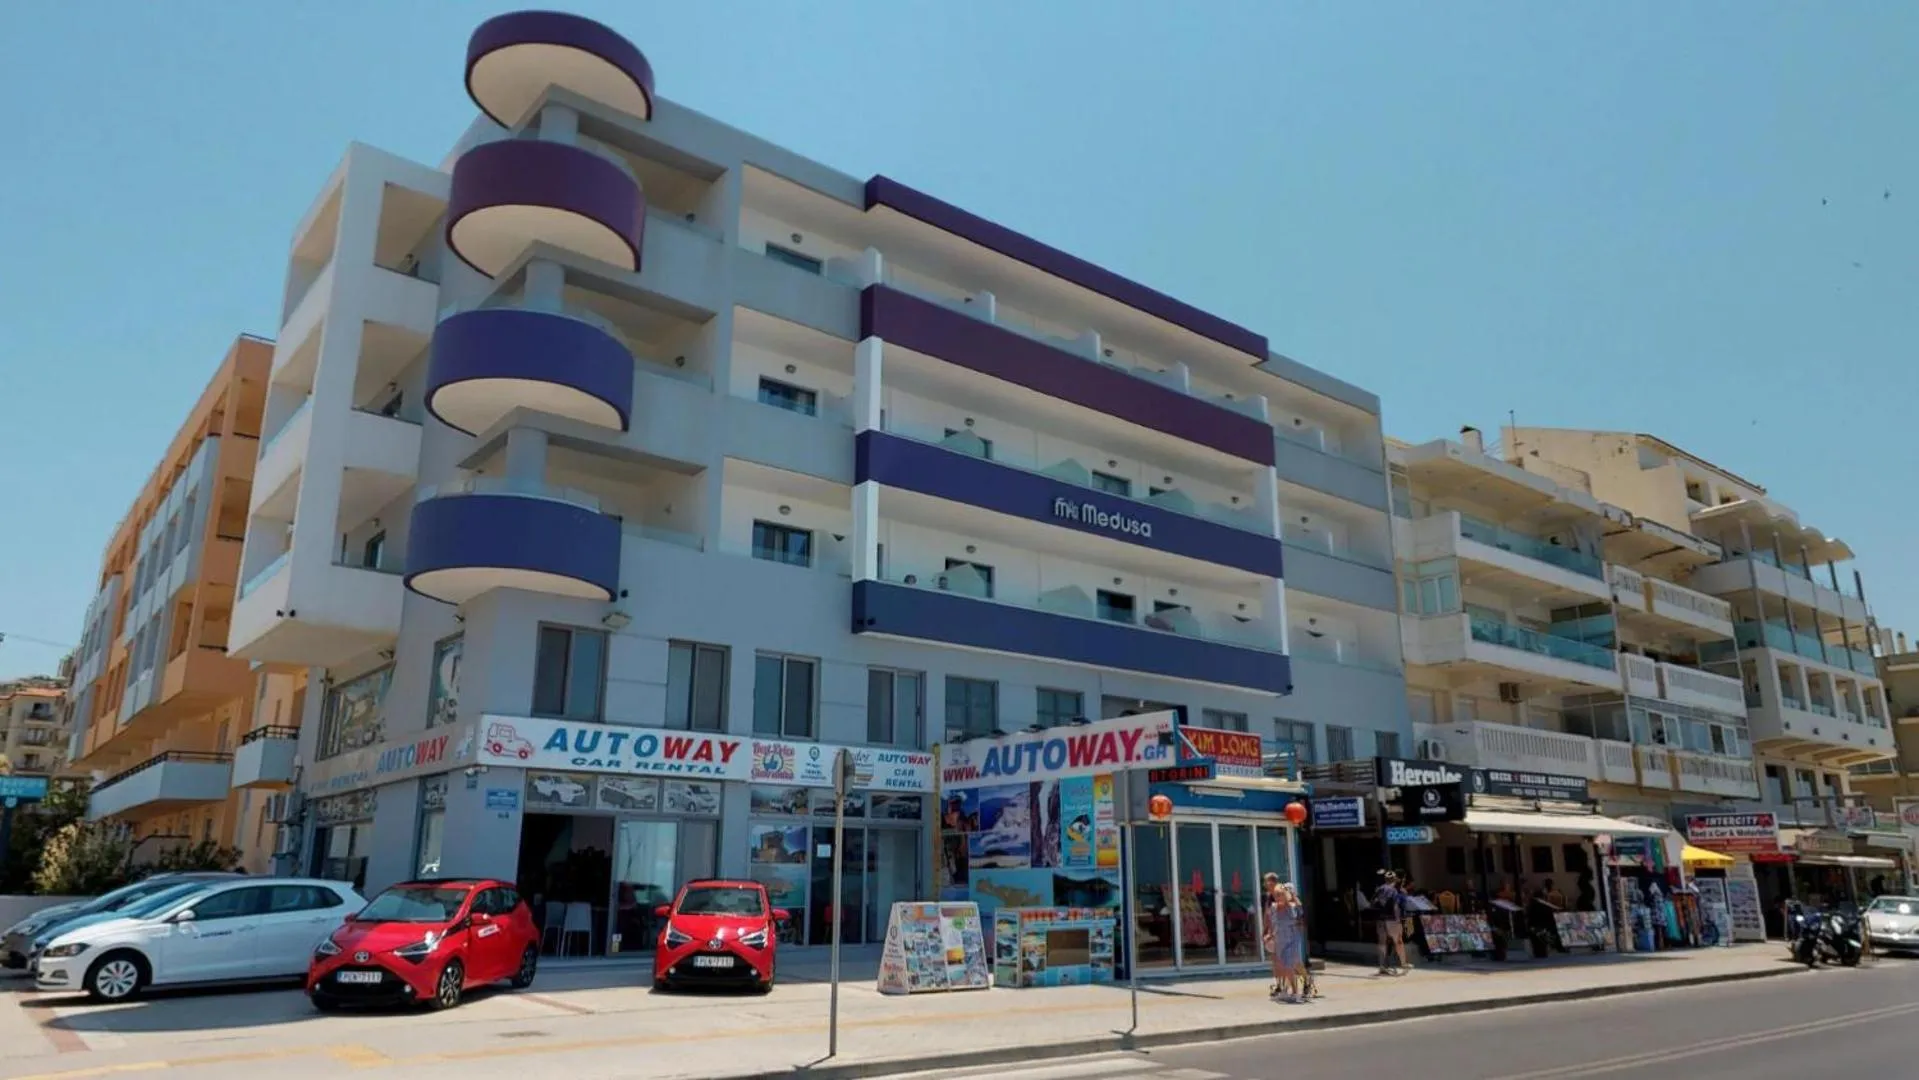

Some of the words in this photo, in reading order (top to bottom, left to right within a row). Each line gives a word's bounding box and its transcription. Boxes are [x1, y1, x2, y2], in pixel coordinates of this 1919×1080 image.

[1081, 503, 1152, 537] Medusa
[376, 735, 449, 773] AUTOWAY
[543, 727, 741, 763] AUTOWAY
[570, 756, 622, 768] CAR
[635, 760, 726, 775] RENTAL
[878, 753, 931, 765] AUTOWAY
[894, 768, 915, 777] CAR
[1389, 760, 1463, 787] Hercules
[885, 778, 922, 788] RENTAL
[1704, 816, 1759, 827] INTERCITY
